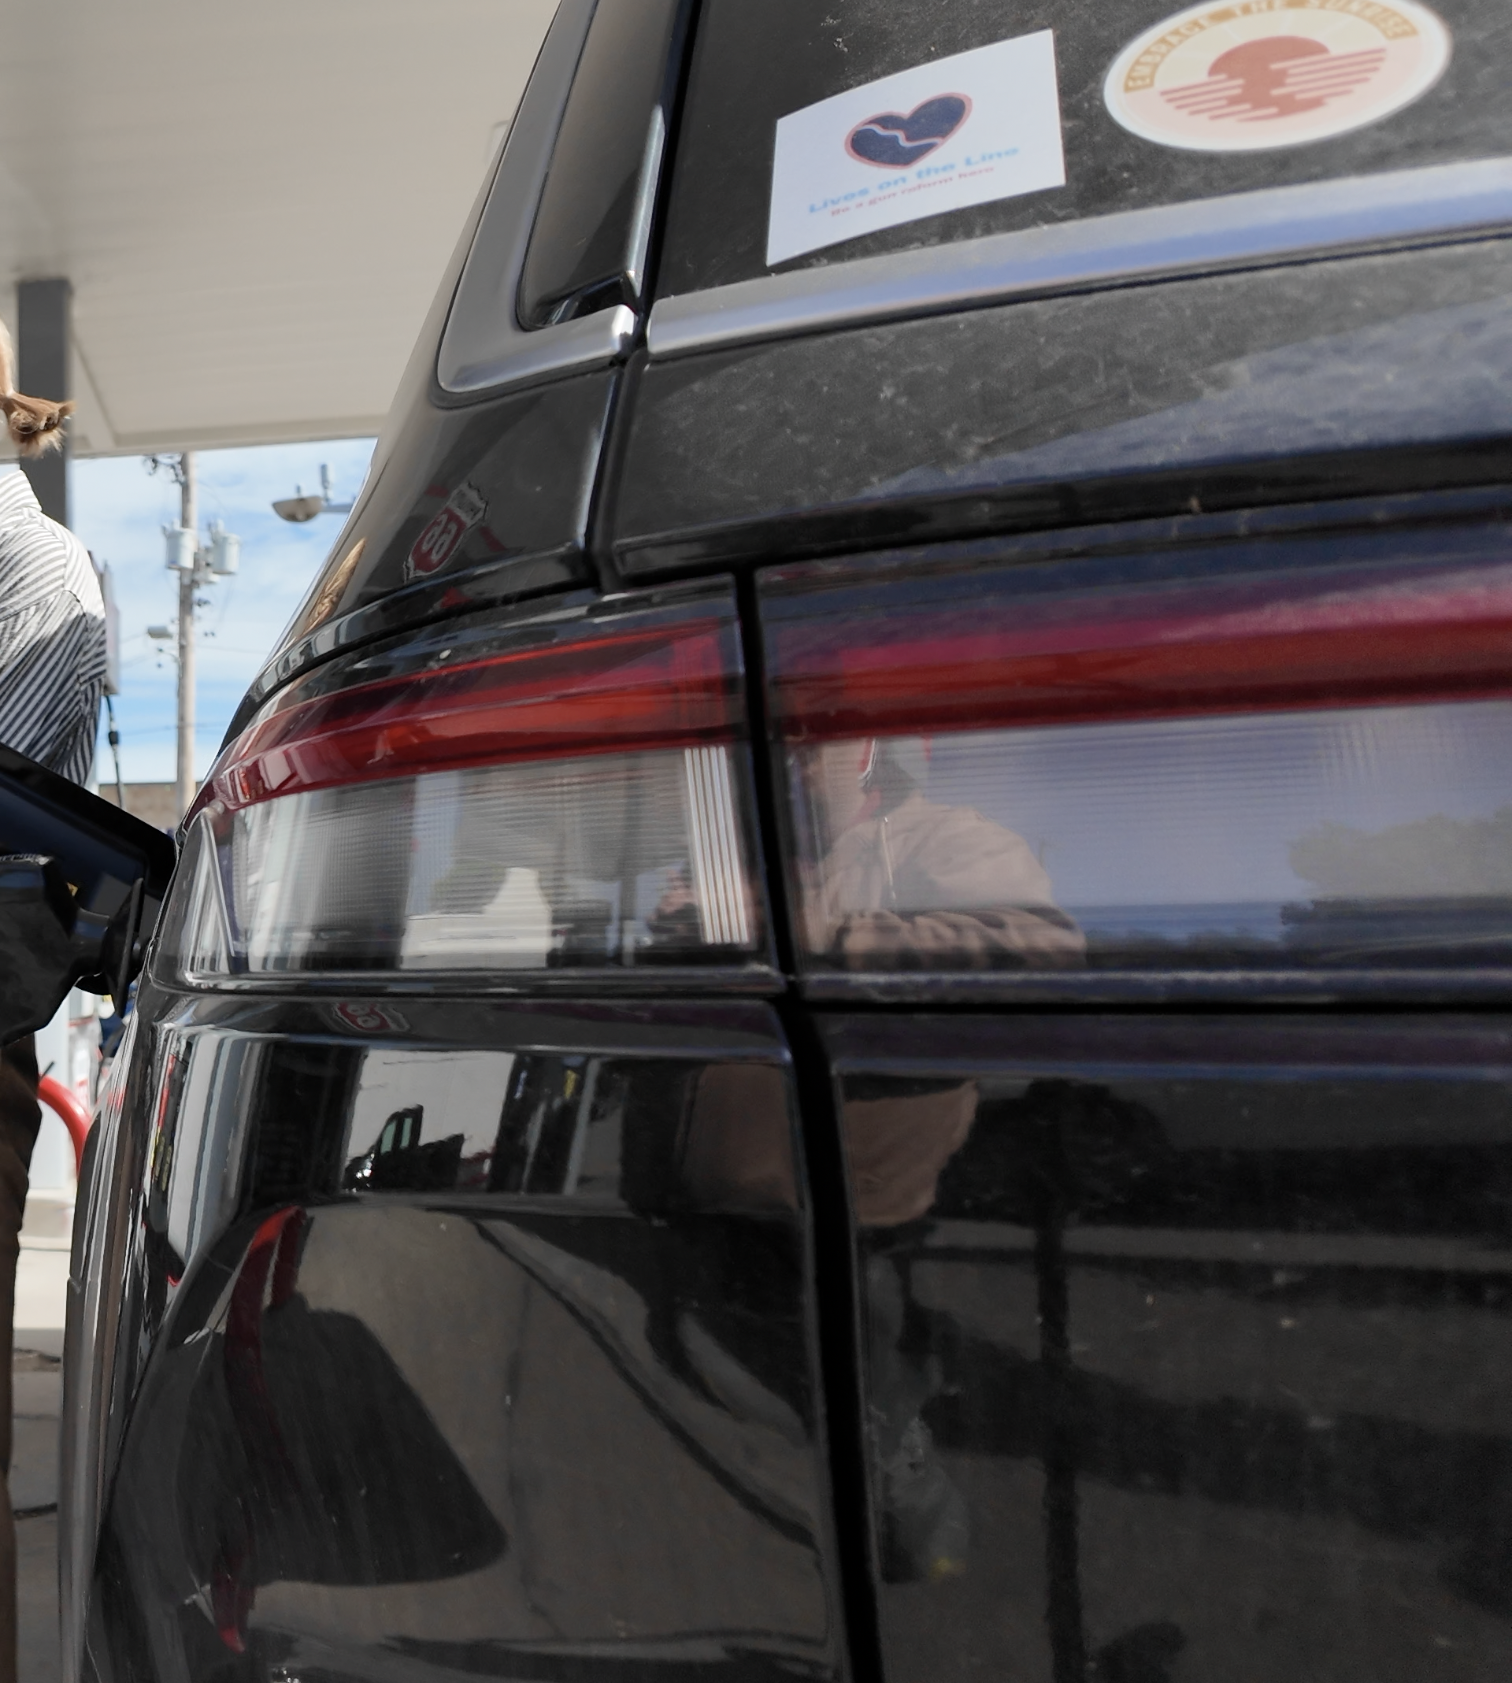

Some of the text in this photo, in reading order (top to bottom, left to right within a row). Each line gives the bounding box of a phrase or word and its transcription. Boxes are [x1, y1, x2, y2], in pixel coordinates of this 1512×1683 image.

[1126, 16, 1209, 89] EMBRACE
[808, 147, 1020, 214] Lives on the Line
